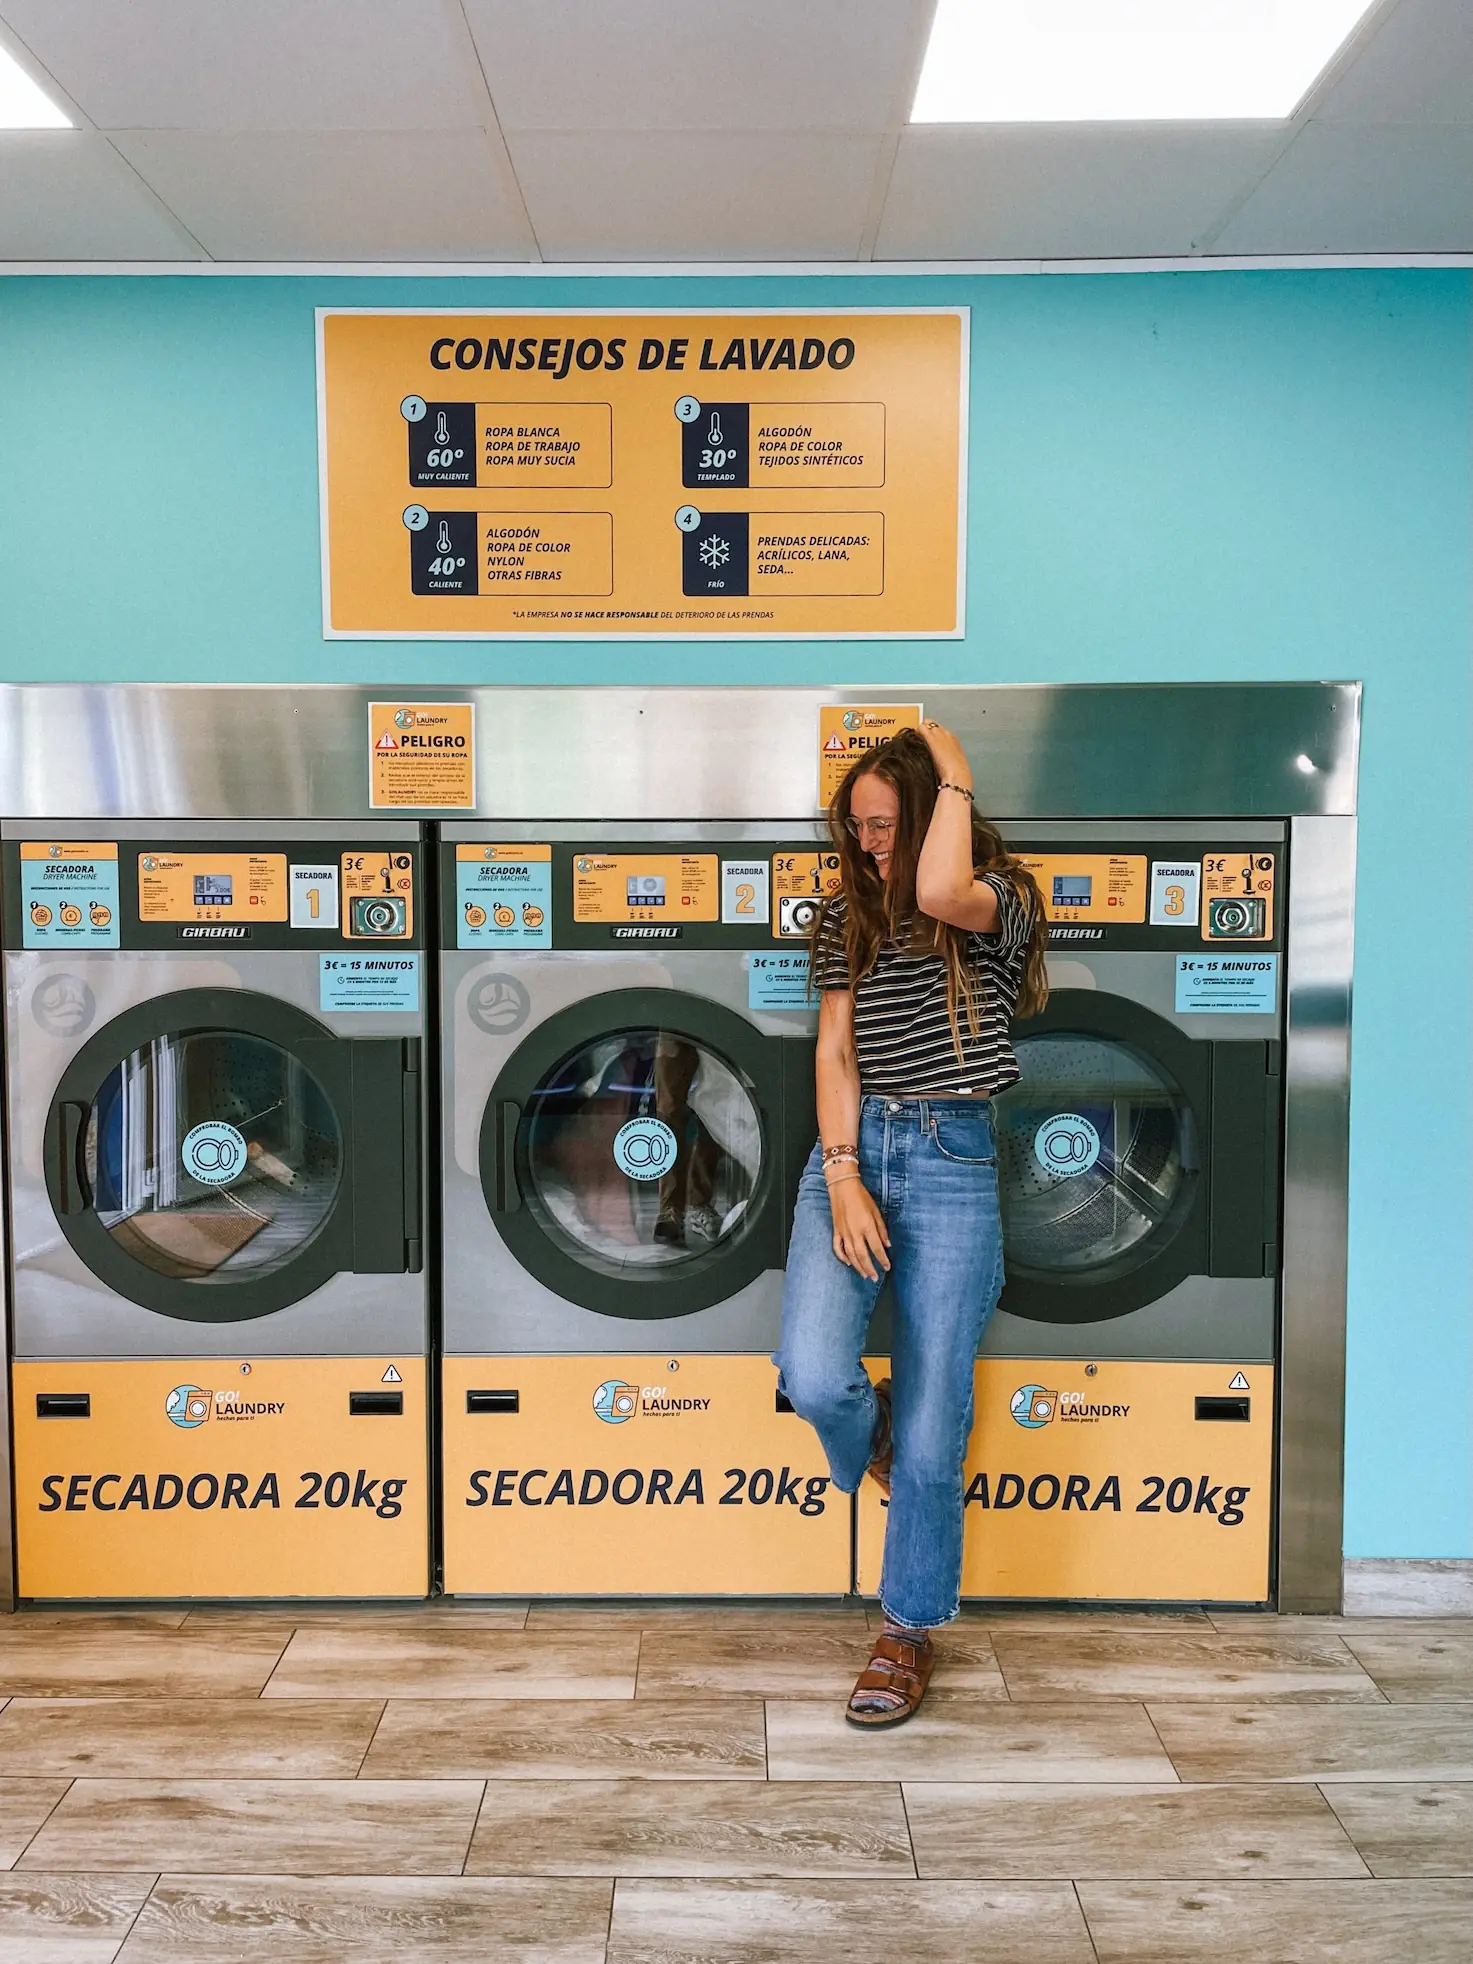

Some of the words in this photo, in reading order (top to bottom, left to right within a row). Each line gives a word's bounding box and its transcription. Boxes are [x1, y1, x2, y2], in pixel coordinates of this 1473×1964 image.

[430, 338, 626, 380] CONSEJOS
[638, 338, 689, 370] DE
[700, 338, 856, 370] LAVADO
[411, 404, 417, 414] 1
[683, 405, 691, 415] 3
[486, 428, 514, 437] ROPA
[517, 428, 560, 437] BLANCA
[758, 425, 812, 437] ALGODÓN
[486, 442, 514, 451] ROPA
[518, 442, 532, 451] DE
[534, 442, 581, 453] TRABAJO
[759, 442, 787, 451] ROPA
[790, 442, 804, 451] DE
[807, 442, 843, 451] COLOR
[486, 456, 514, 465] ROPA
[518, 456, 542, 465] MUY
[544, 456, 576, 465] SUCIA
[759, 456, 800, 467] TEJIDOS
[803, 454, 864, 465] SINTÉTICOS
[412, 513, 420, 524] 2
[684, 514, 692, 524] 4
[487, 527, 540, 538] ALGODÓN
[758, 537, 806, 546] PRENDAS
[809, 537, 870, 546] DELICADAS:
[487, 543, 516, 552] ROPA
[519, 543, 533, 552] DE
[536, 543, 571, 552] COLOR
[757, 549, 815, 561] ACRÍLICOS,
[818, 551, 850, 561] LANA,
[488, 557, 525, 566] NYLON
[758, 565, 794, 574] SEDA...
[488, 571, 522, 580] OTRAS
[525, 571, 562, 580] FIBRAS
[708, 580, 725, 588] FRÍO
[402, 736, 465, 747] PELIGRO
[480, 867, 528, 875] SECADORA
[1157, 869, 1195, 877] SECADORA
[307, 889, 319, 918] 1
[736, 884, 755, 913] 2
[1164, 886, 1185, 915] 3
[183, 928, 245, 937] GIRBAU
[616, 928, 678, 937] GIRBAU
[365, 962, 414, 970] MINUTOS
[779, 960, 789, 968] 15
[1222, 963, 1272, 971] MINUTOS
[620, 1120, 649, 1137] COMPROBAR
[657, 1123, 672, 1140] BOMBO
[1042, 1116, 1072, 1132] COMPROBAR
[1080, 1120, 1096, 1136] BOMBO
[190, 1124, 220, 1140] COMPROBAR
[228, 1128, 243, 1145] BOMBO
[640, 1168, 667, 1179] SECADORA
[1061, 1164, 1088, 1175] SECADORA
[208, 1173, 236, 1183] SECADORA
[215, 1391, 240, 1403] GO!
[642, 1387, 667, 1399] GO!
[1060, 1392, 1085, 1404] GO!
[217, 1403, 285, 1414] LAUNDRY
[643, 1399, 711, 1410] LAUNDRY
[1061, 1405, 1130, 1417] LAUNDRY
[38, 1473, 281, 1512] SECADORA
[295, 1470, 407, 1519] 20kg
[466, 1468, 705, 1507] SECADORA
[719, 1467, 831, 1517] 20kg
[880, 1473, 1123, 1512] ADORA
[1136, 1476, 1251, 1526] 20kg
